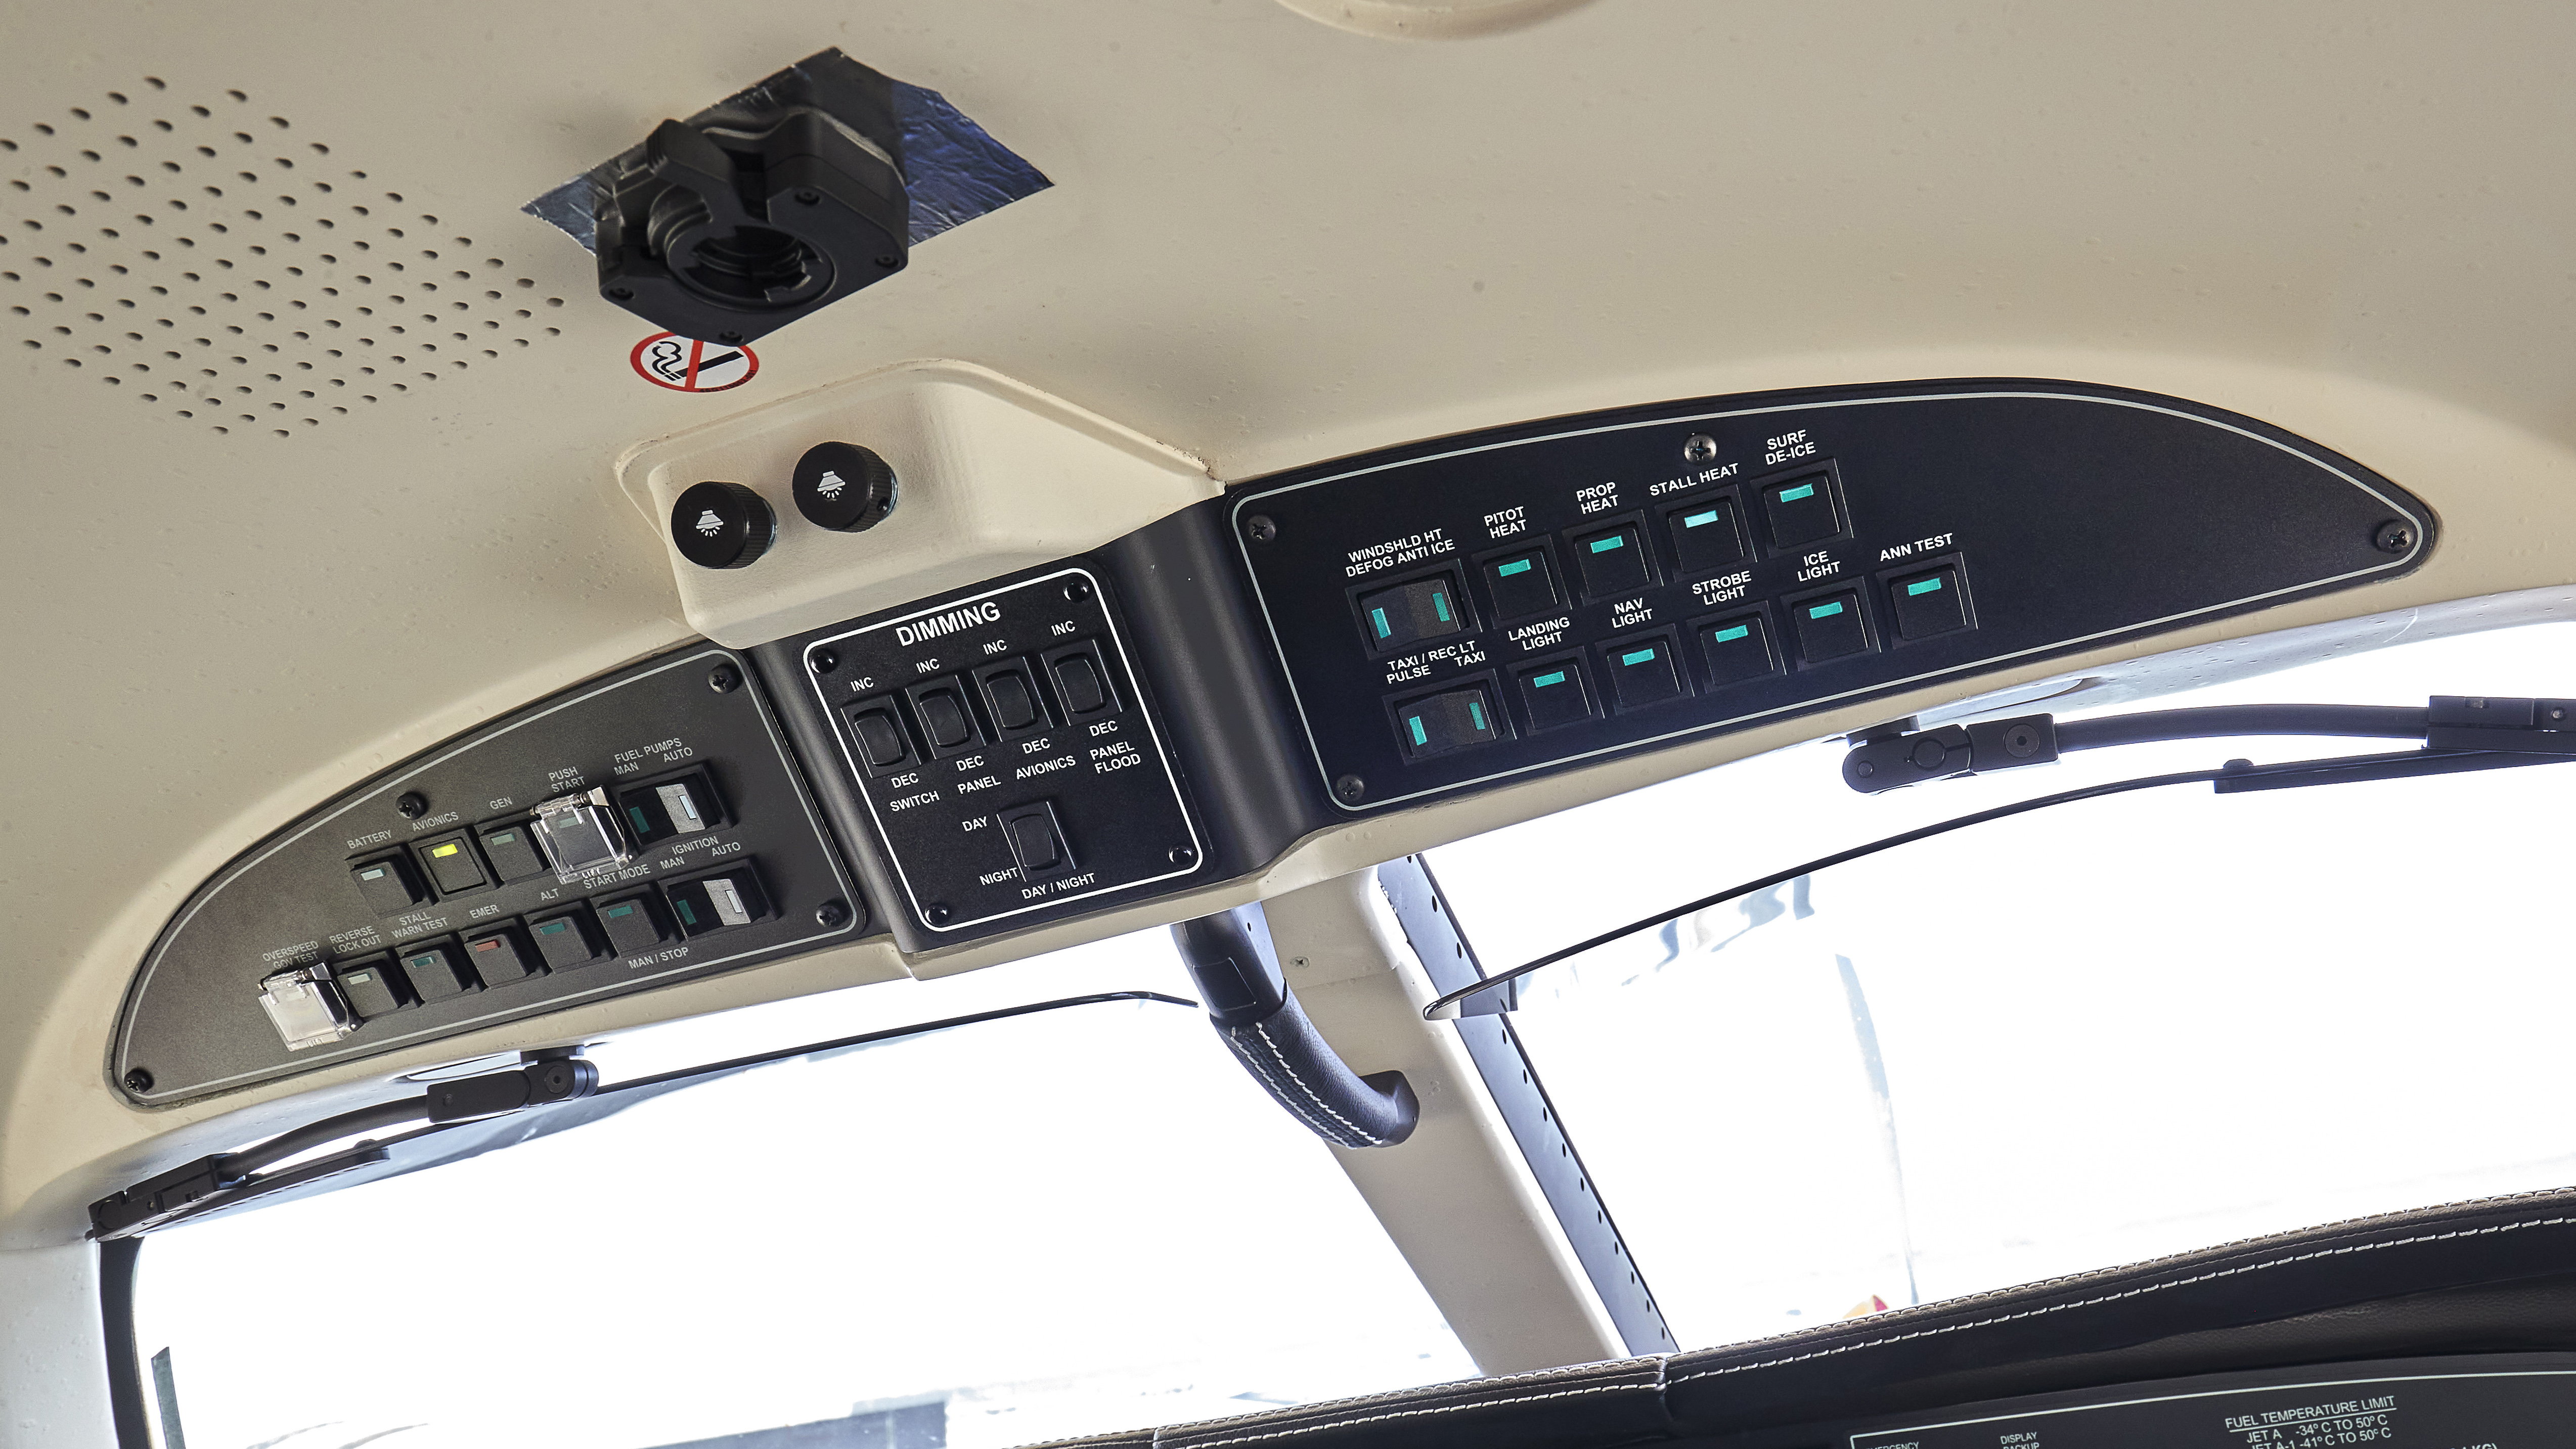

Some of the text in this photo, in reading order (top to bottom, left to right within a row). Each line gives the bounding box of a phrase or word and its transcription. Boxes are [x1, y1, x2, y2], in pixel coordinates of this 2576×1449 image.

[1767, 430, 1806, 449] SURF
[1765, 442, 1815, 465] DE-ICE
[1650, 463, 1738, 495] STALL HEAT
[1577, 482, 1615, 501] PROP
[1581, 495, 1618, 514] HEAT
[1484, 506, 1523, 526] PITOT
[1490, 519, 1526, 538] HEAT
[1348, 528, 1441, 562] WINDSHLD HT
[1881, 533, 1952, 561] ANN TEST
[1346, 539, 1455, 577] DEFOG ANTI ICE
[1804, 551, 1829, 566] ICE
[1798, 561, 1840, 581] LIGHT
[1693, 571, 1751, 594] STROBE
[1704, 585, 1745, 605] LIGHT
[1614, 598, 1642, 614] NAV
[896, 602, 1000, 646] DIMMING
[1612, 609, 1652, 628] LIGHT
[1051, 621, 1075, 636] INC
[1508, 617, 1570, 641] LANDING
[983, 640, 1007, 655] INC
[1522, 631, 1562, 650] LIGHT
[1388, 656, 1418, 670] TAXI
[1428, 646, 1456, 661] REC
[1459, 641, 1475, 653] LT
[916, 659, 939, 673] INC
[1387, 651, 1485, 684] PULSE TAXI
[851, 677, 873, 691] INC
[1089, 721, 1118, 736] DEC
[614, 738, 681, 763] FUEL PUMPS
[1022, 738, 1050, 753] DEC
[1090, 742, 1135, 760] PANEL
[614, 747, 692, 775] MAN AUTO
[956, 756, 984, 771] DEC
[1017, 755, 1076, 779] AVIONICS
[1095, 754, 1140, 774] FLOOD
[549, 767, 578, 781] PUSH
[891, 773, 918, 788] DEC
[551, 777, 584, 792] START
[958, 776, 1001, 794] PANEL
[490, 797, 512, 809] GEN
[890, 791, 940, 811] SWITCH
[413, 812, 458, 831] AVIONICS
[962, 817, 987, 831] DAY
[347, 830, 391, 848] BATTERY
[672, 836, 718, 854] IGNITION
[660, 842, 740, 869] MAN AUTO
[584, 864, 650, 888] START MODE
[980, 868, 1017, 885] NIGHT
[1021, 884, 1046, 898] DAY
[1056, 873, 1094, 890] NIGHT
[541, 888, 558, 900] ALT
[399, 912, 431, 925] STALL
[470, 905, 499, 918] EMER
[329, 926, 375, 943] REVERSE
[391, 918, 447, 938] WARN TEST
[262, 941, 318, 961] OVERSPEED
[333, 935, 381, 953] LOCK OUT
[274, 951, 318, 969] GOV TEST
[629, 956, 653, 968] MAN
[660, 947, 688, 961] STOP
[2226, 1396, 2393, 1428] FUEL TEMPERATURE LIMIT
[2001, 1432, 2036, 1444] DISPLAY
[2247, 1430, 2268, 1443] JET
[2274, 1429, 2282, 1439] A
[2322, 1422, 2331, 1432] C
[2333, 1419, 2352, 1430] TO
[2378, 1415, 2387, 1425] C
[2325, 1435, 2335, 1445] C
[2337, 1432, 2357, 1443] TO
[2381, 1427, 2391, 1438] C
